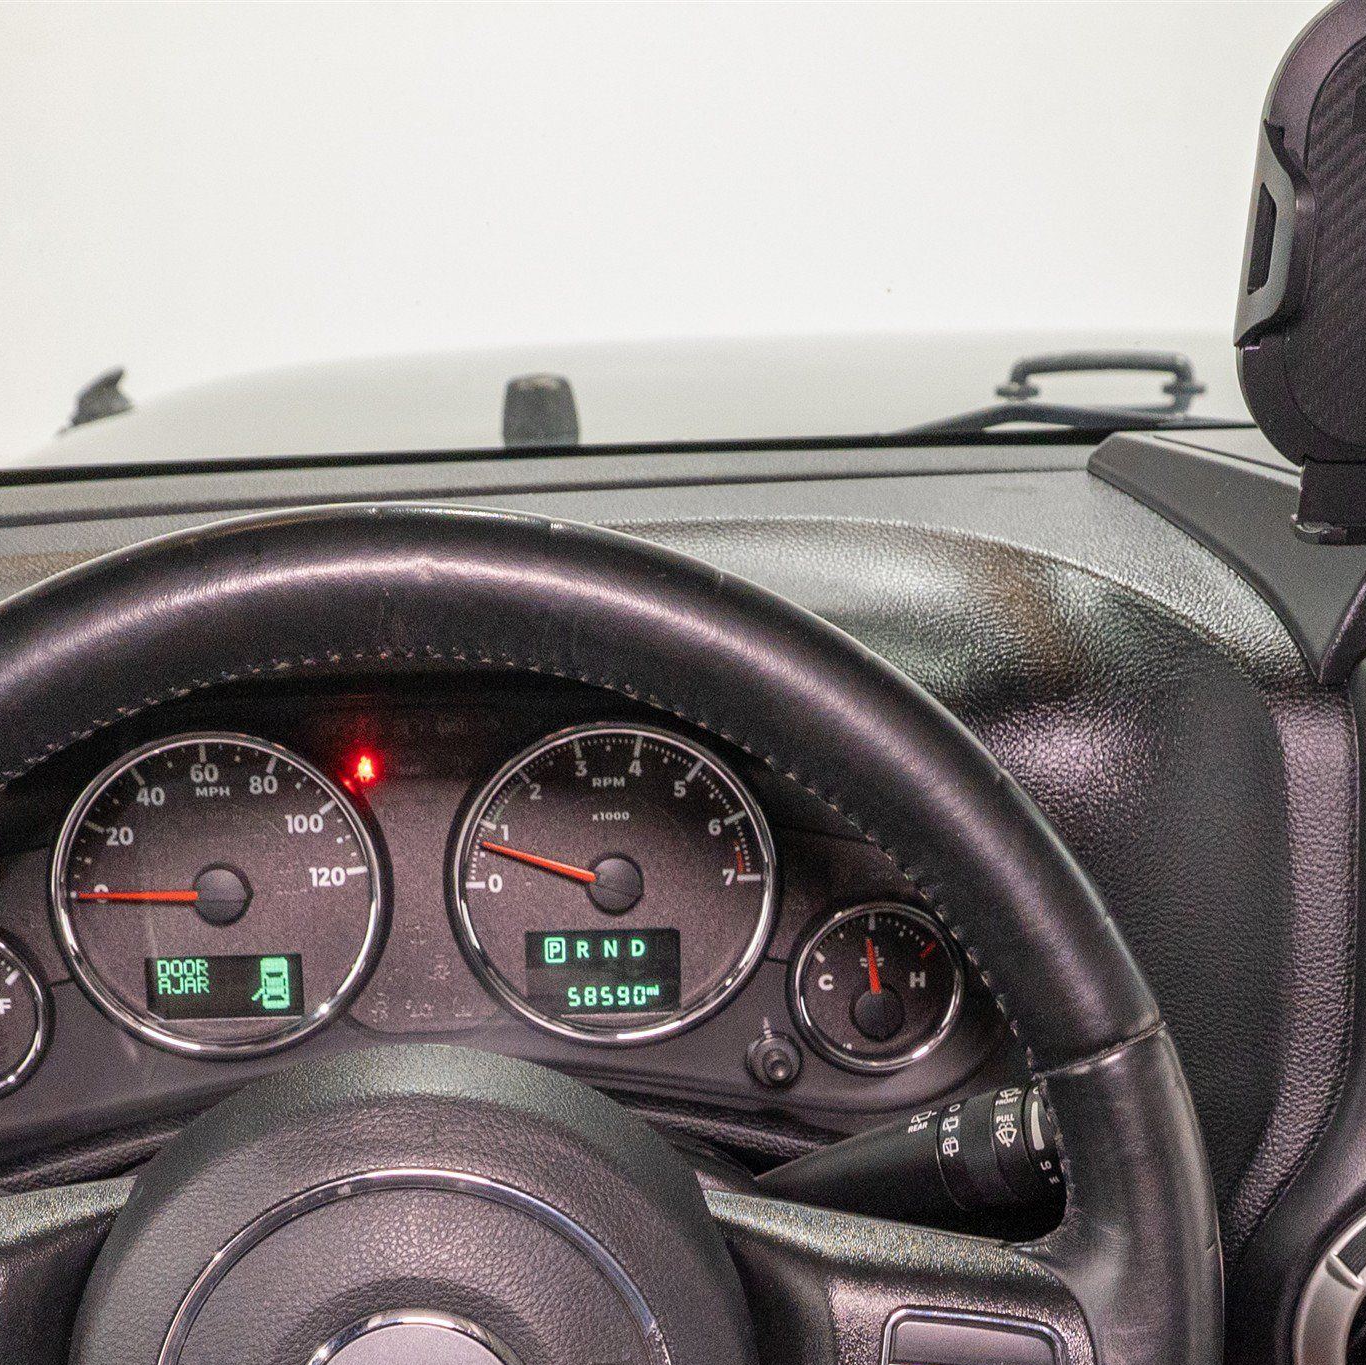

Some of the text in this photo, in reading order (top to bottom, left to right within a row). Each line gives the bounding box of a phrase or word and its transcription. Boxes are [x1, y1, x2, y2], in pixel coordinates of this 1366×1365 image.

[190, 763, 219, 783] 60
[575, 760, 587, 777] 3
[628, 760, 642, 777] 4
[249, 775, 278, 796] 80
[529, 783, 542, 800] 2
[592, 777, 625, 788] RPM
[673, 781, 686, 799] 5
[136, 786, 166, 807] 40
[195, 786, 231, 798] MPH
[285, 813, 324, 834] 100
[592, 811, 630, 821] x1000
[499, 824, 509, 841] 1
[708, 818, 721, 835] 6
[105, 826, 134, 846] 20
[309, 867, 346, 887] 120
[487, 874, 503, 893] 0
[722, 868, 734, 886] 7
[576, 940, 590, 958] R
[603, 940, 618, 958] N
[631, 939, 646, 957] D
[157, 959, 209, 977] DOOR
[158, 977, 210, 995] AJAR
[818, 971, 927, 991] C H
[907, 1121, 928, 1133] REAR
[996, 1113, 1015, 1123] PULL
